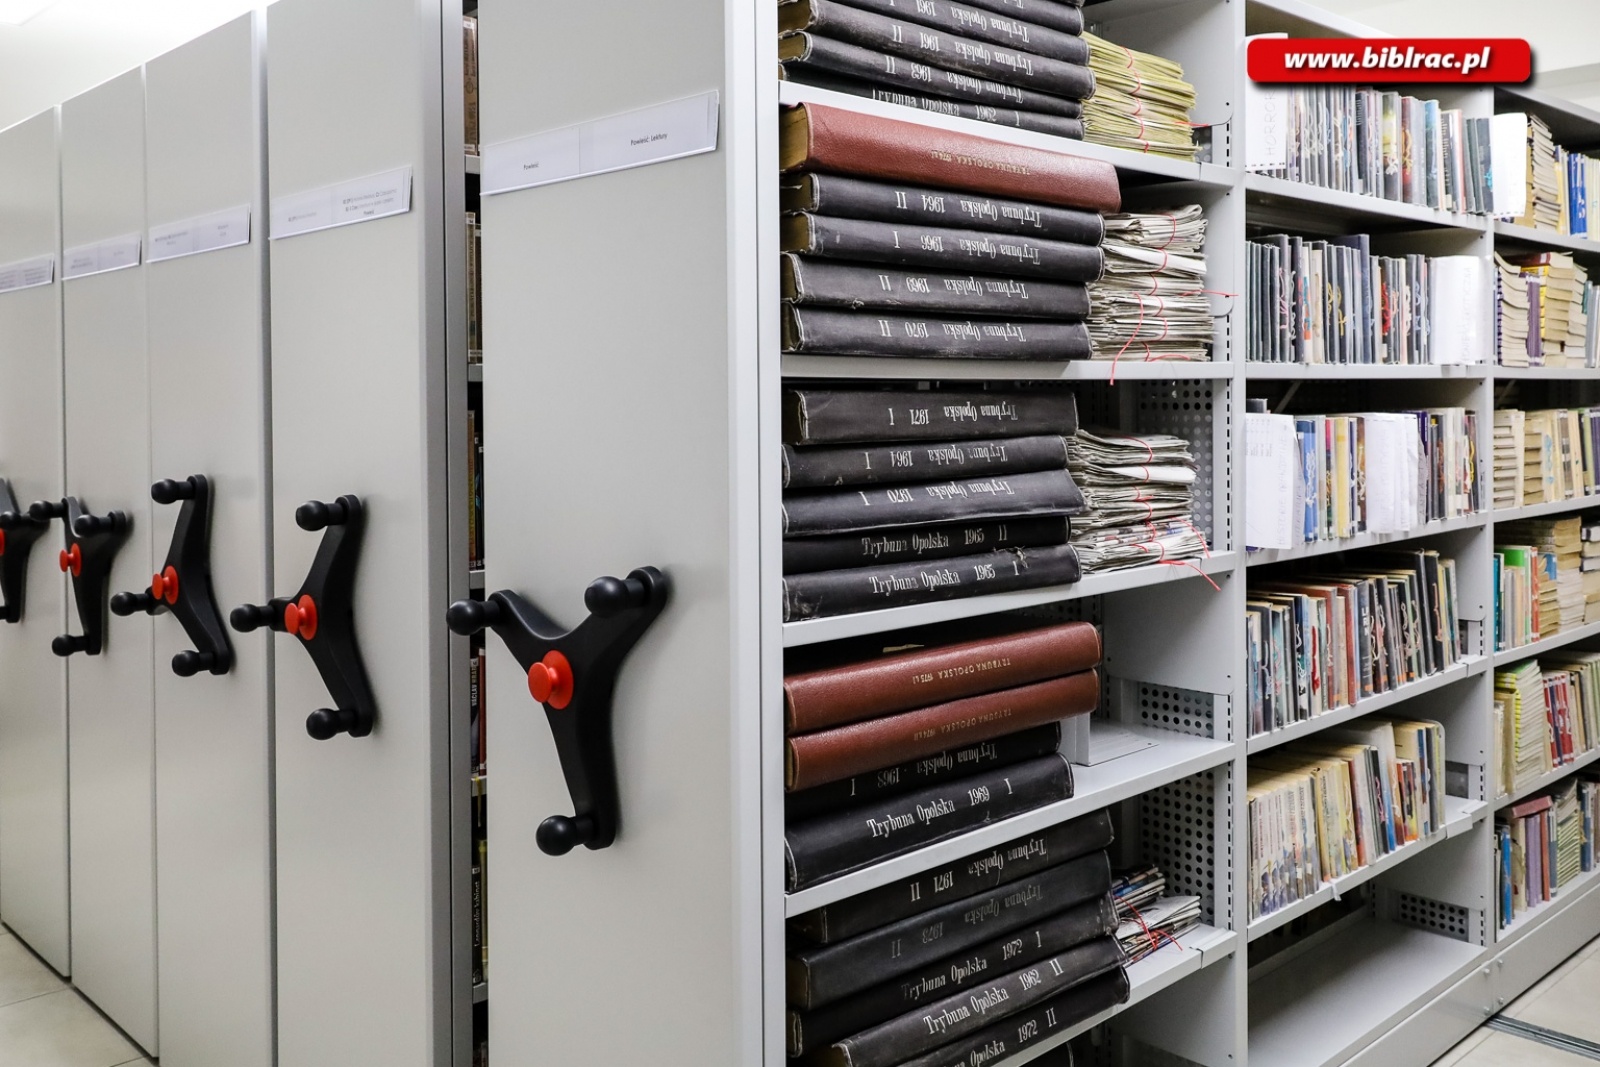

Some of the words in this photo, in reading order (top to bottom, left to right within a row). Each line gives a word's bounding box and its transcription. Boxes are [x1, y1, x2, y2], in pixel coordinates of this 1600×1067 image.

[917, 0, 937, 16] 1961
[951, 7, 987, 31] Opolska
[892, 24, 902, 43] II
[991, 19, 1029, 43] Trybuna
[919, 31, 940, 52] 1961
[955, 41, 991, 66] Opolska
[885, 54, 896, 75] II
[910, 63, 933, 82] 1963
[995, 51, 1033, 76] Trybuna
[946, 71, 982, 95] Opolska
[986, 83, 1023, 104] Trybuna
[975, 104, 997, 122] 1962
[957, 155, 994, 169] OPOLSKA
[895, 191, 907, 209] II
[921, 194, 946, 213] 1964
[960, 199, 998, 221] Opolska
[1002, 206, 1042, 228] Trybuna
[893, 230, 901, 249] I
[921, 235, 943, 251] 1966
[960, 238, 996, 258] Opolska
[1000, 243, 1041, 265] Trybuna
[879, 274, 891, 291] II
[906, 277, 930, 293] 1969
[944, 276, 983, 296] Opolska
[986, 280, 1029, 299] Trybuna
[878, 319, 892, 337] II
[905, 321, 929, 338] 1970
[942, 321, 981, 341] Opolska
[984, 323, 1027, 341] Trybuna
[888, 407, 895, 425] I
[910, 408, 930, 425] 1971
[943, 402, 978, 422] Opolska
[981, 402, 1019, 421] Trybuna
[864, 452, 872, 470] I
[890, 450, 914, 468] 1964
[928, 445, 965, 464] Opolska
[969, 444, 1008, 462] Trybuna
[887, 487, 914, 502] 1970
[925, 481, 969, 499] Opolska
[967, 480, 1015, 496] Trybuna
[858, 491, 871, 506] I
[862, 536, 908, 558] Trybuna
[912, 531, 950, 555] Opolska
[964, 528, 985, 545] 1965
[998, 524, 1008, 541] II
[869, 573, 918, 596] Trybuna
[920, 569, 961, 592] Opolska
[973, 564, 996, 581] 1965
[1012, 560, 1020, 576] I
[938, 664, 975, 680] OPOLSKA
[975, 657, 1012, 673] TRYBUNA
[920, 671, 934, 683] 1975
[940, 717, 977, 734] OPOLSKA
[957, 742, 997, 764] Trybuna
[916, 751, 954, 775] Opolska
[850, 778, 856, 797] I
[867, 811, 915, 837] Trybuna
[916, 798, 955, 825] Opolska
[967, 786, 990, 806] 1969
[1003, 777, 1013, 795] I
[1007, 838, 1047, 861] Trybuna
[968, 852, 1004, 877] Opolska
[933, 870, 954, 892] 1971
[910, 882, 921, 902] II
[1004, 884, 1043, 909] Trybuna
[964, 898, 1000, 924] Opolska
[922, 921, 944, 944] 1973
[890, 938, 901, 959] II
[901, 972, 946, 1000] Trybuna
[950, 957, 988, 985] Opolska
[1001, 939, 1023, 960] 1972
[1035, 931, 1043, 948] I
[923, 1006, 970, 1035] Trybuna
[970, 986, 1009, 1014] Opolska
[1018, 969, 1042, 991] 1962
[1049, 958, 1064, 976] II
[969, 1040, 1006, 1067] Opolska
[1017, 1022, 1038, 1044] 1972
[1046, 1007, 1058, 1028] II
